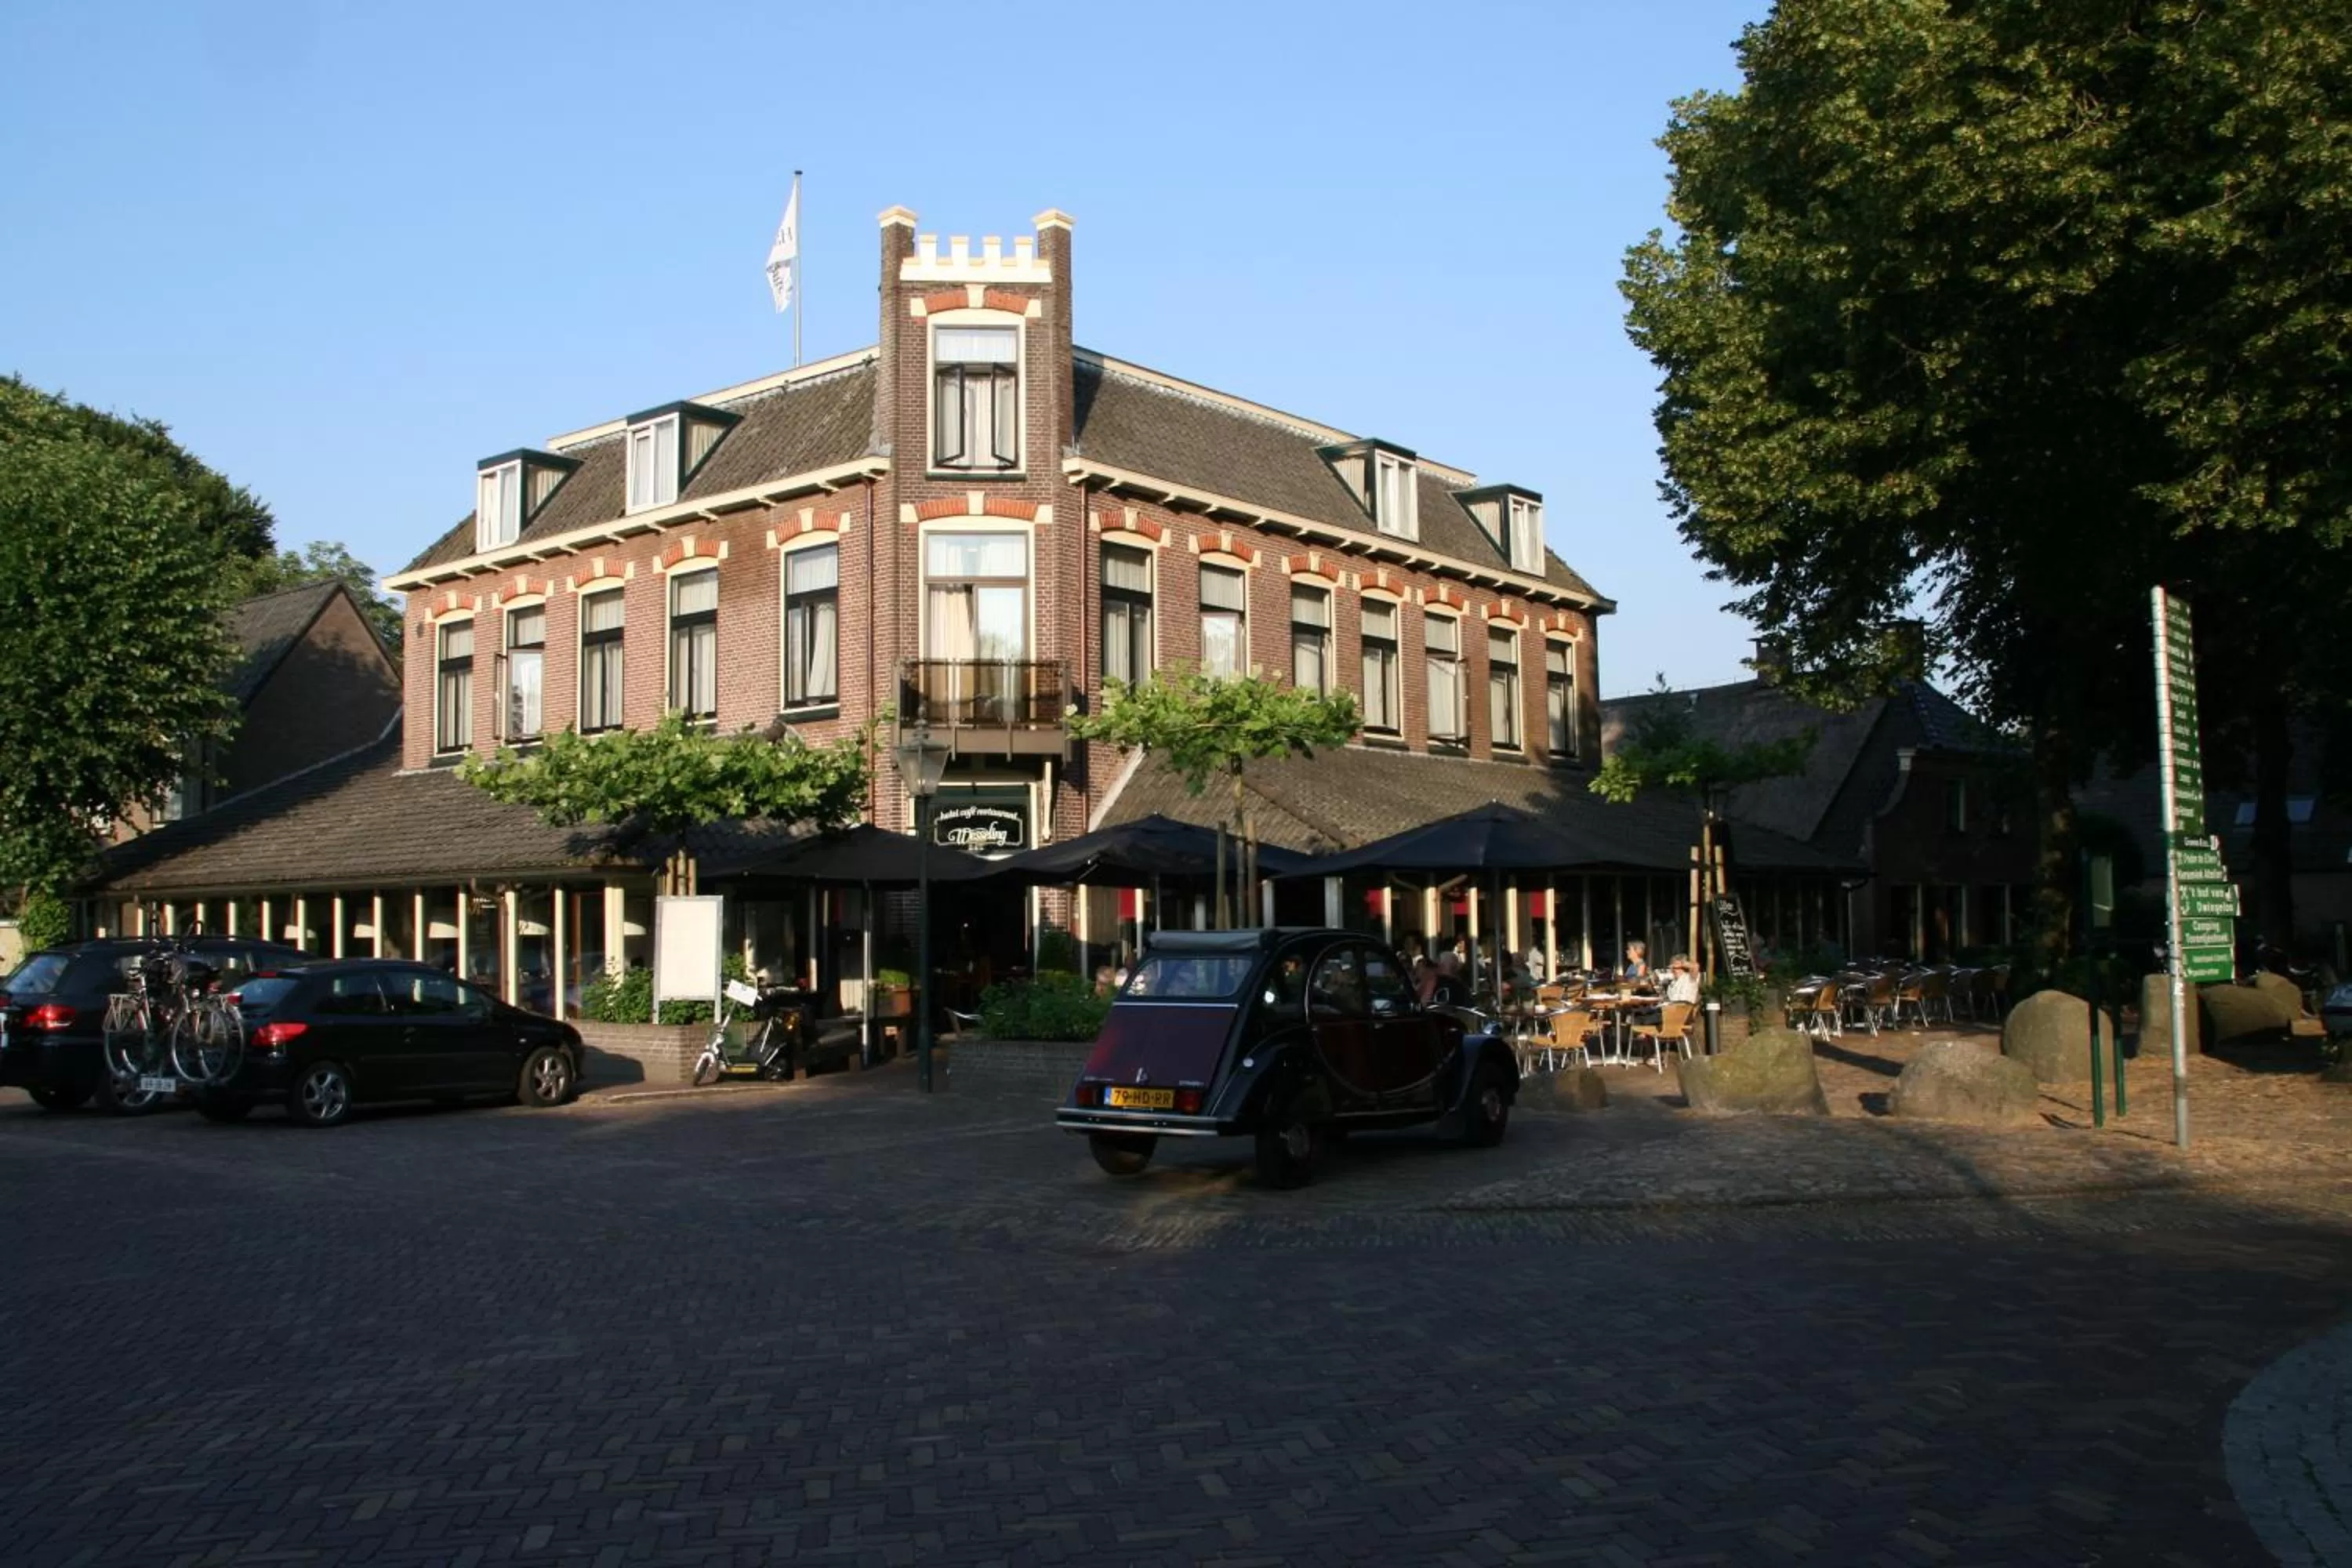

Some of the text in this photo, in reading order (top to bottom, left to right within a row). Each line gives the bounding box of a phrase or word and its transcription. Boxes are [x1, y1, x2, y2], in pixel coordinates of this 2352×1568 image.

[941, 808, 959, 820] hotel
[977, 808, 1018, 819] restaurant
[948, 821, 1007, 847] Wesseling
